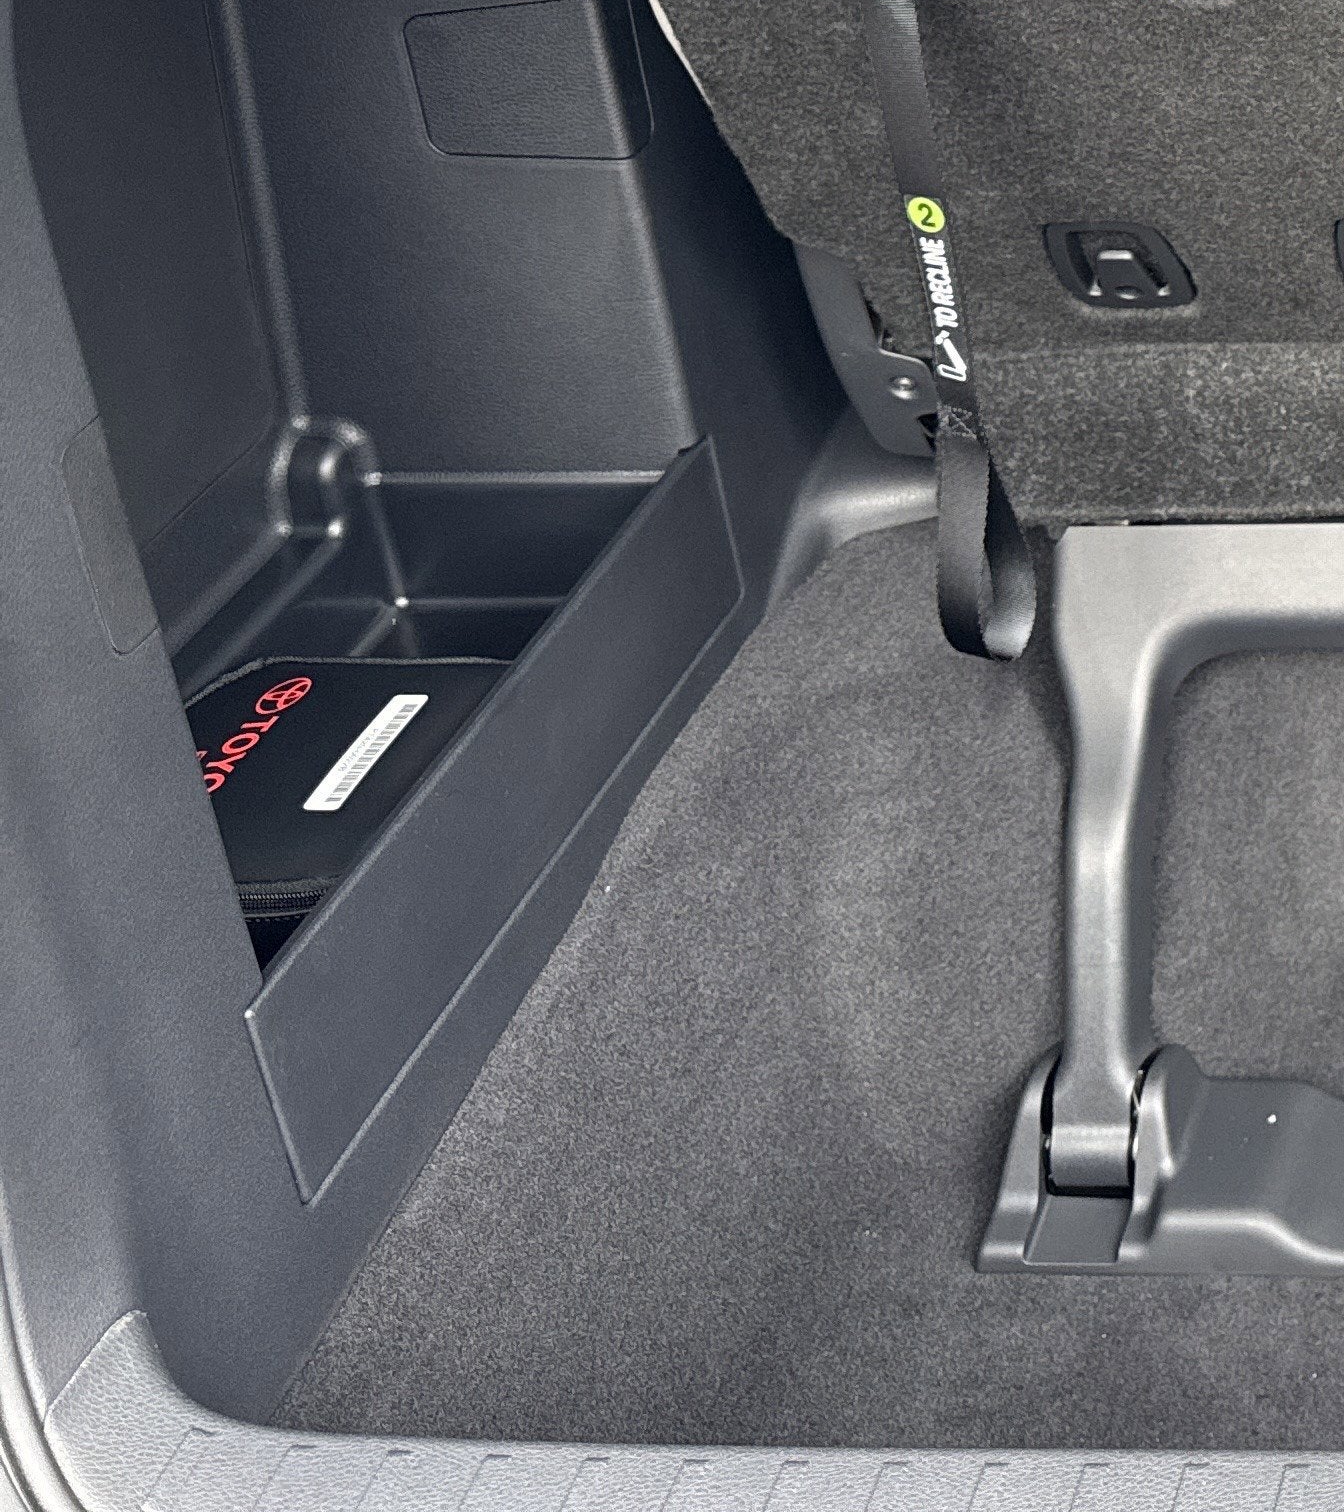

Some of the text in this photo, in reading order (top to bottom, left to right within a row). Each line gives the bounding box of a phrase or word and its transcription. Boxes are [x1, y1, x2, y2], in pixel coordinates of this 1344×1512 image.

[917, 203, 936, 228] 2
[919, 236, 958, 328] TO RECLINE
